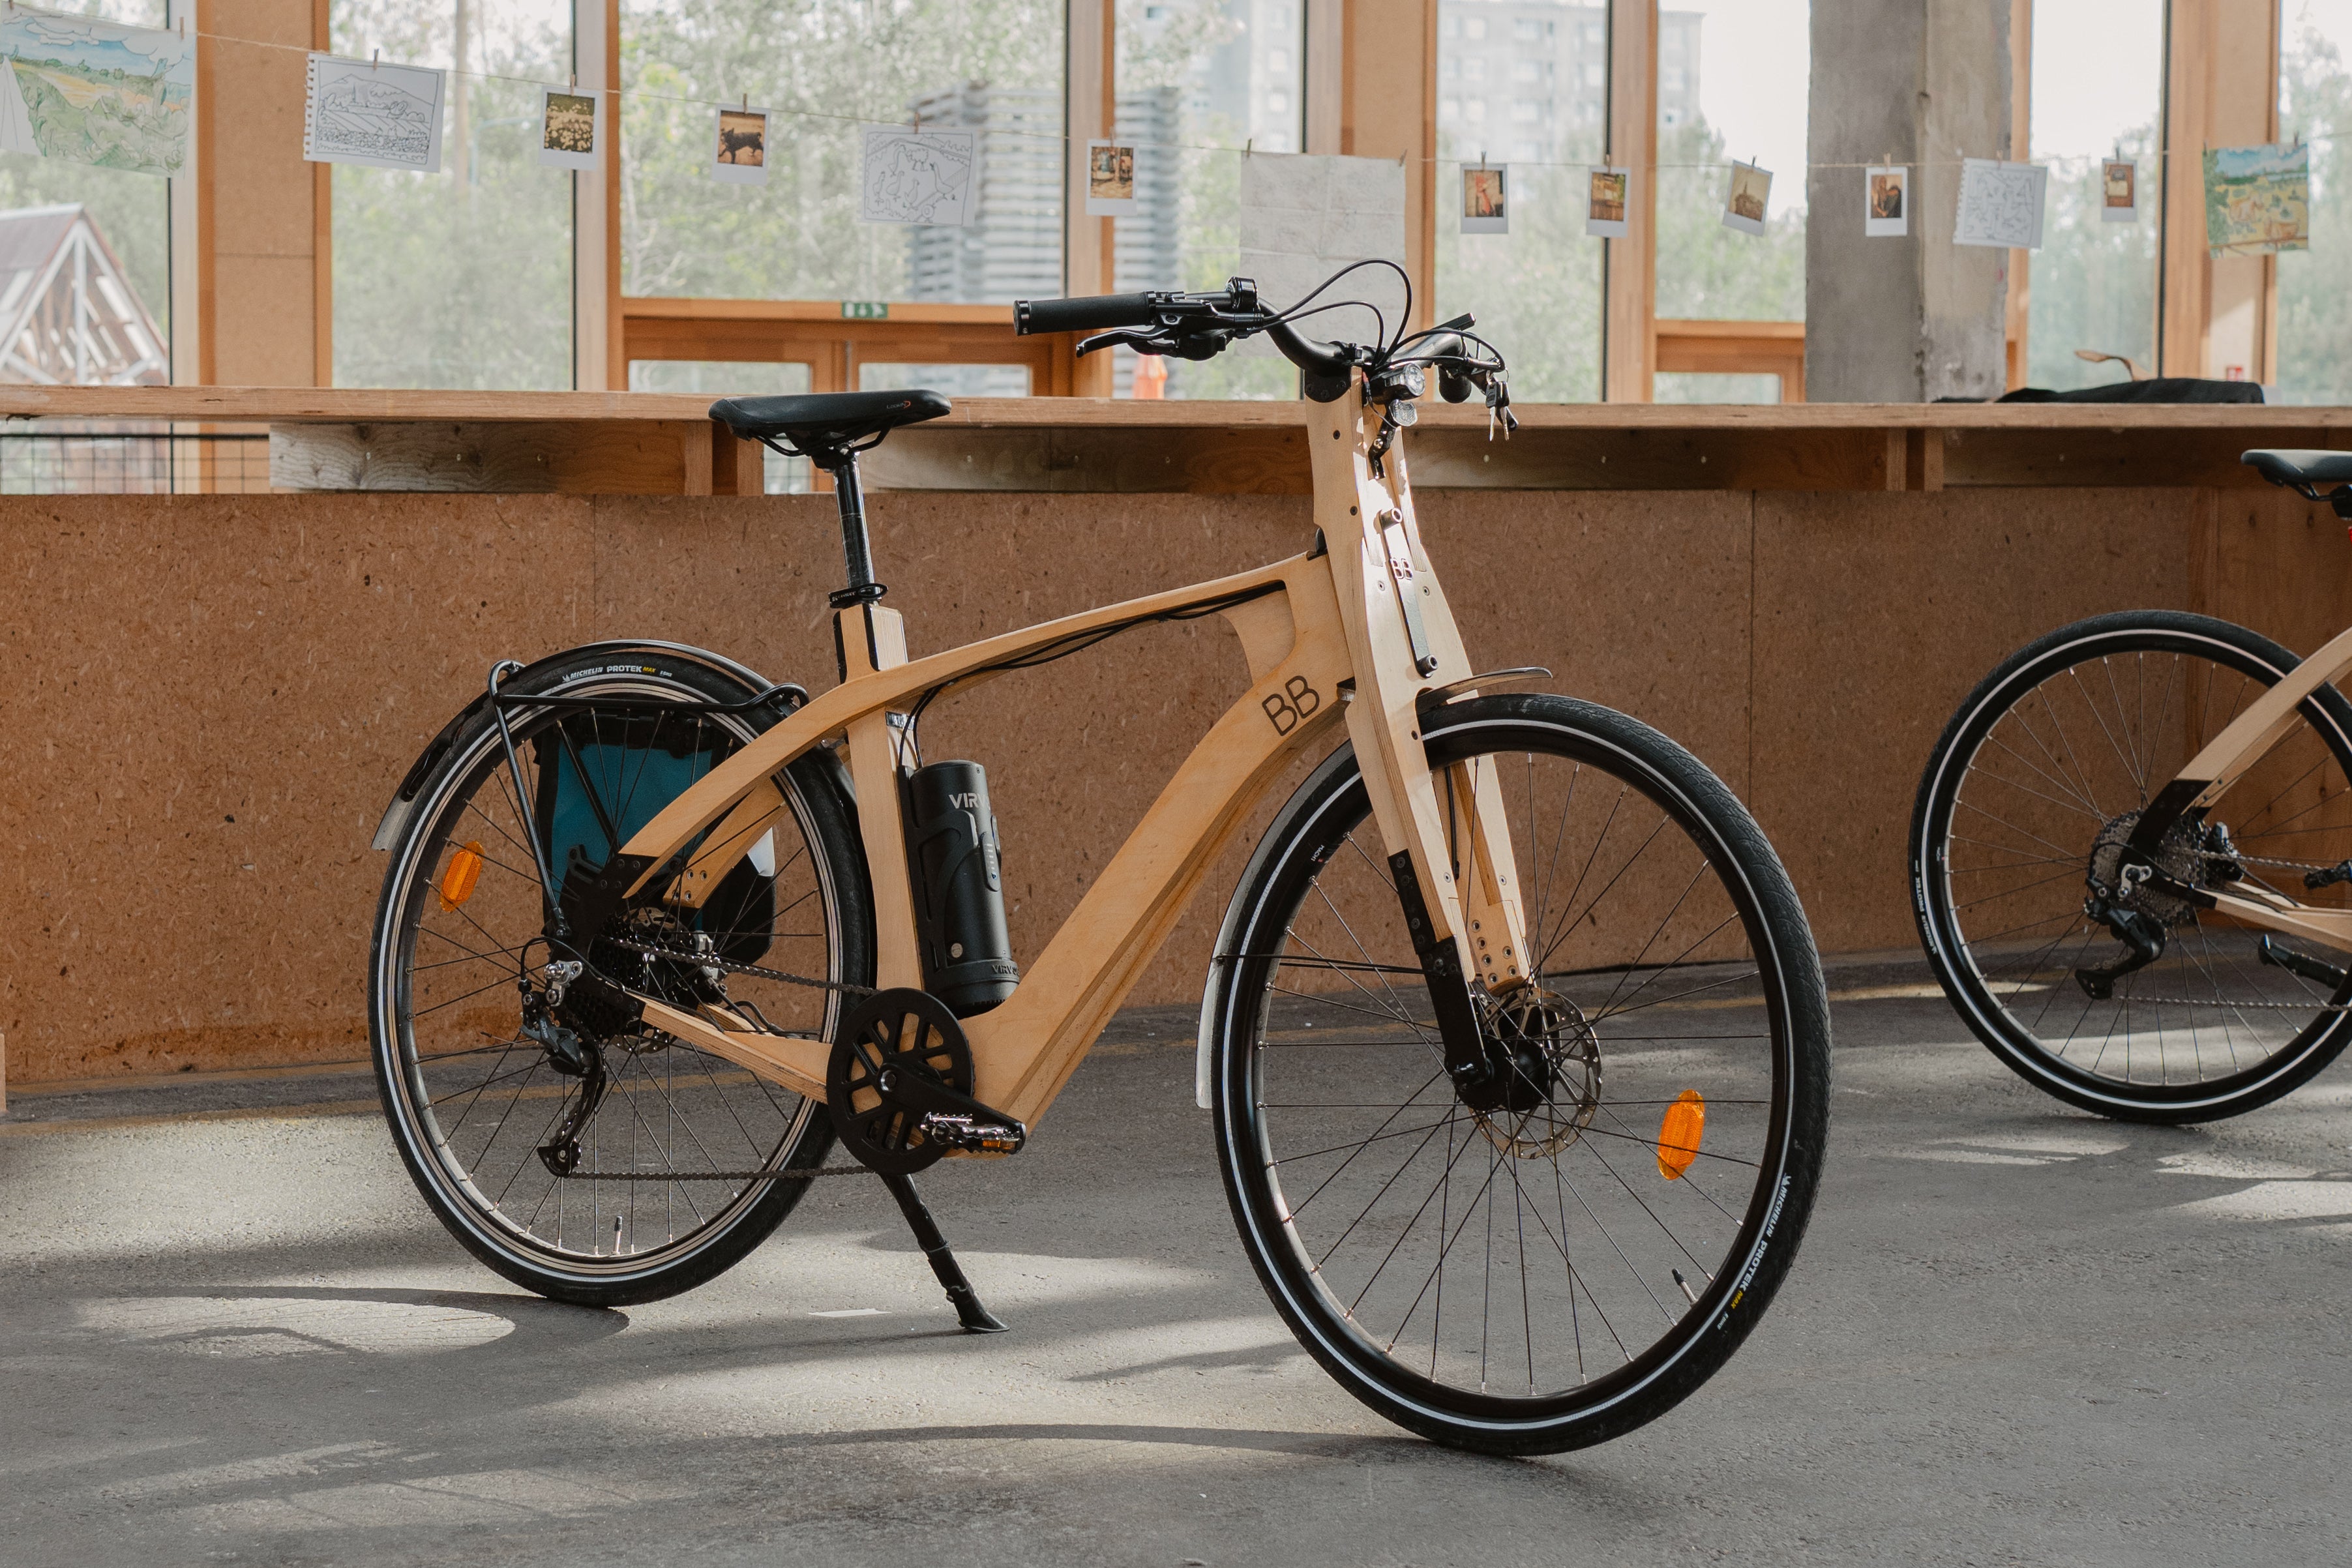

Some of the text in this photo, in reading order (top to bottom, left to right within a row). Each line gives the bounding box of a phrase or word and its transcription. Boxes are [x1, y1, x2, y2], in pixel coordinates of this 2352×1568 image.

[1390, 557, 1413, 580] BB
[570, 666, 604, 679] MICHELIN
[1262, 675, 1320, 736] BB
[1766, 1186, 1787, 1237] MICHELIN
[1740, 1240, 1768, 1292] PROTEK
[1731, 1290, 1743, 1309] MAX
